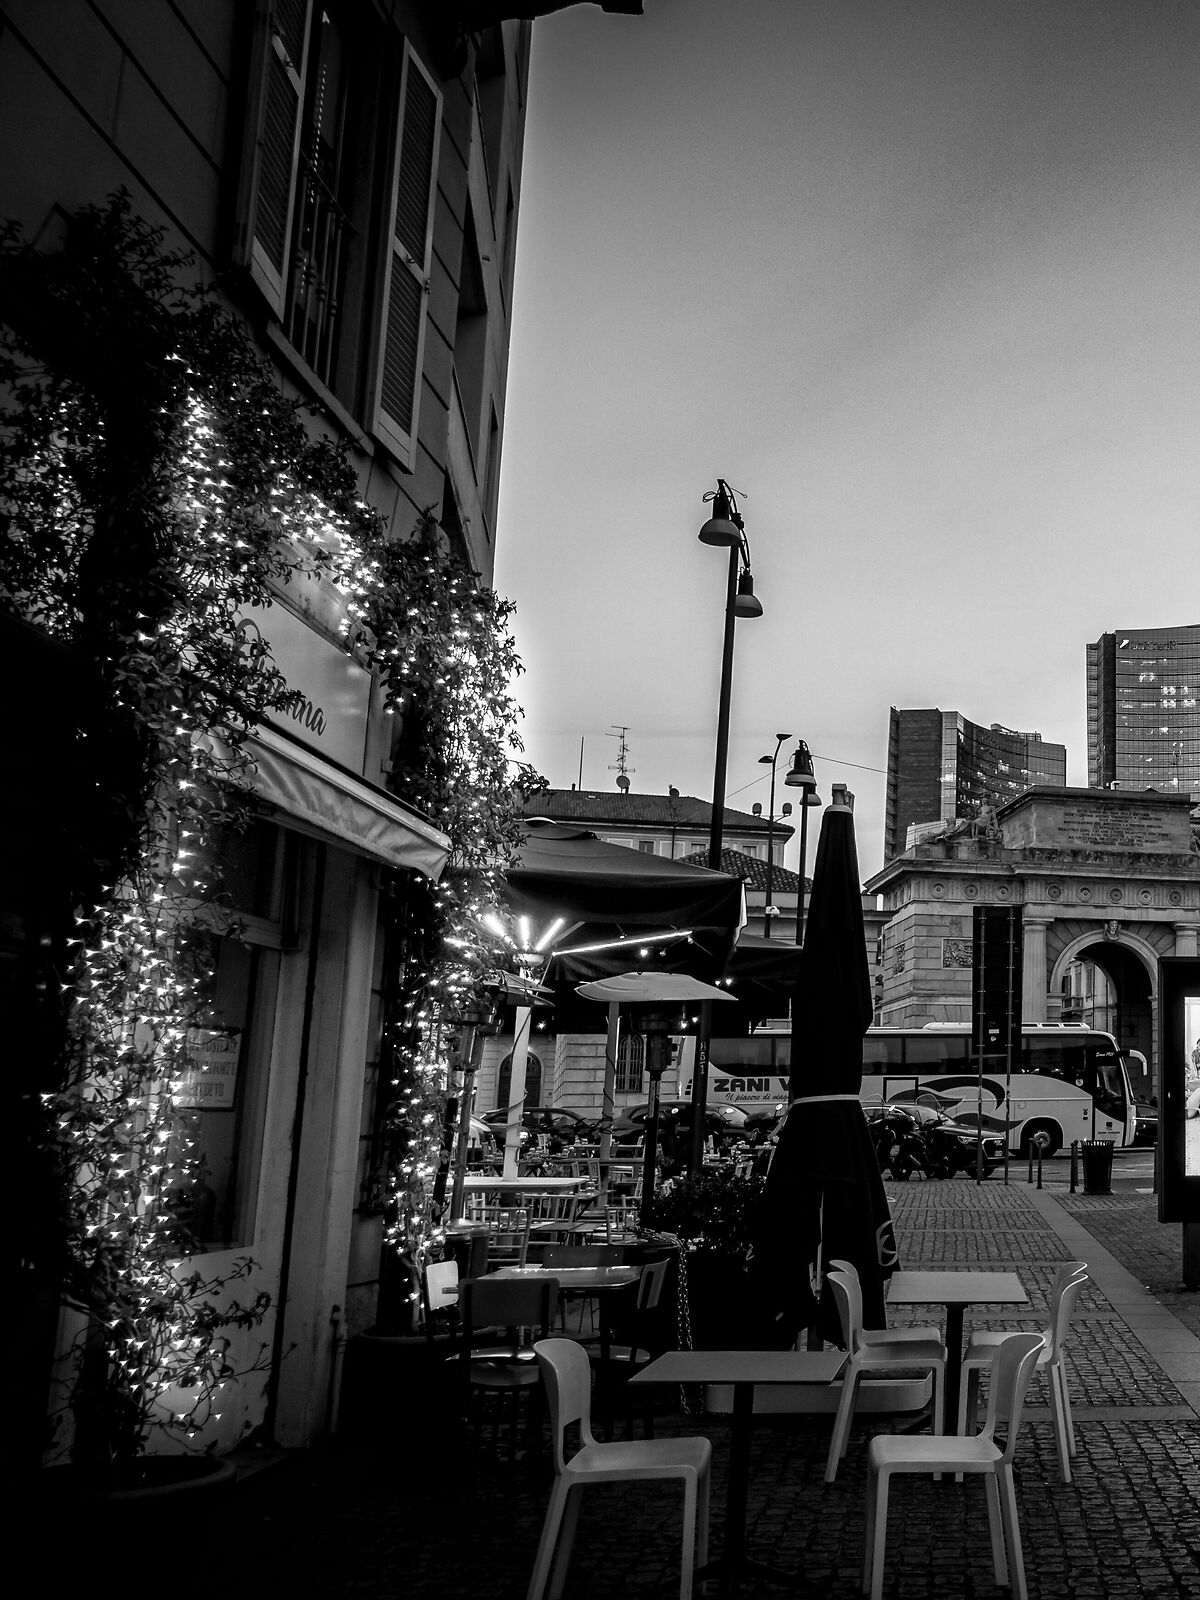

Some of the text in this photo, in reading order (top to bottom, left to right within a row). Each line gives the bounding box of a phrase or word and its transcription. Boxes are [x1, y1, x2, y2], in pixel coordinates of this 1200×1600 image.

[714, 1078, 770, 1092] ZANI
[735, 1094, 760, 1103] piacere
[762, 1092, 771, 1101] di
[772, 1094, 788, 1102] viag
